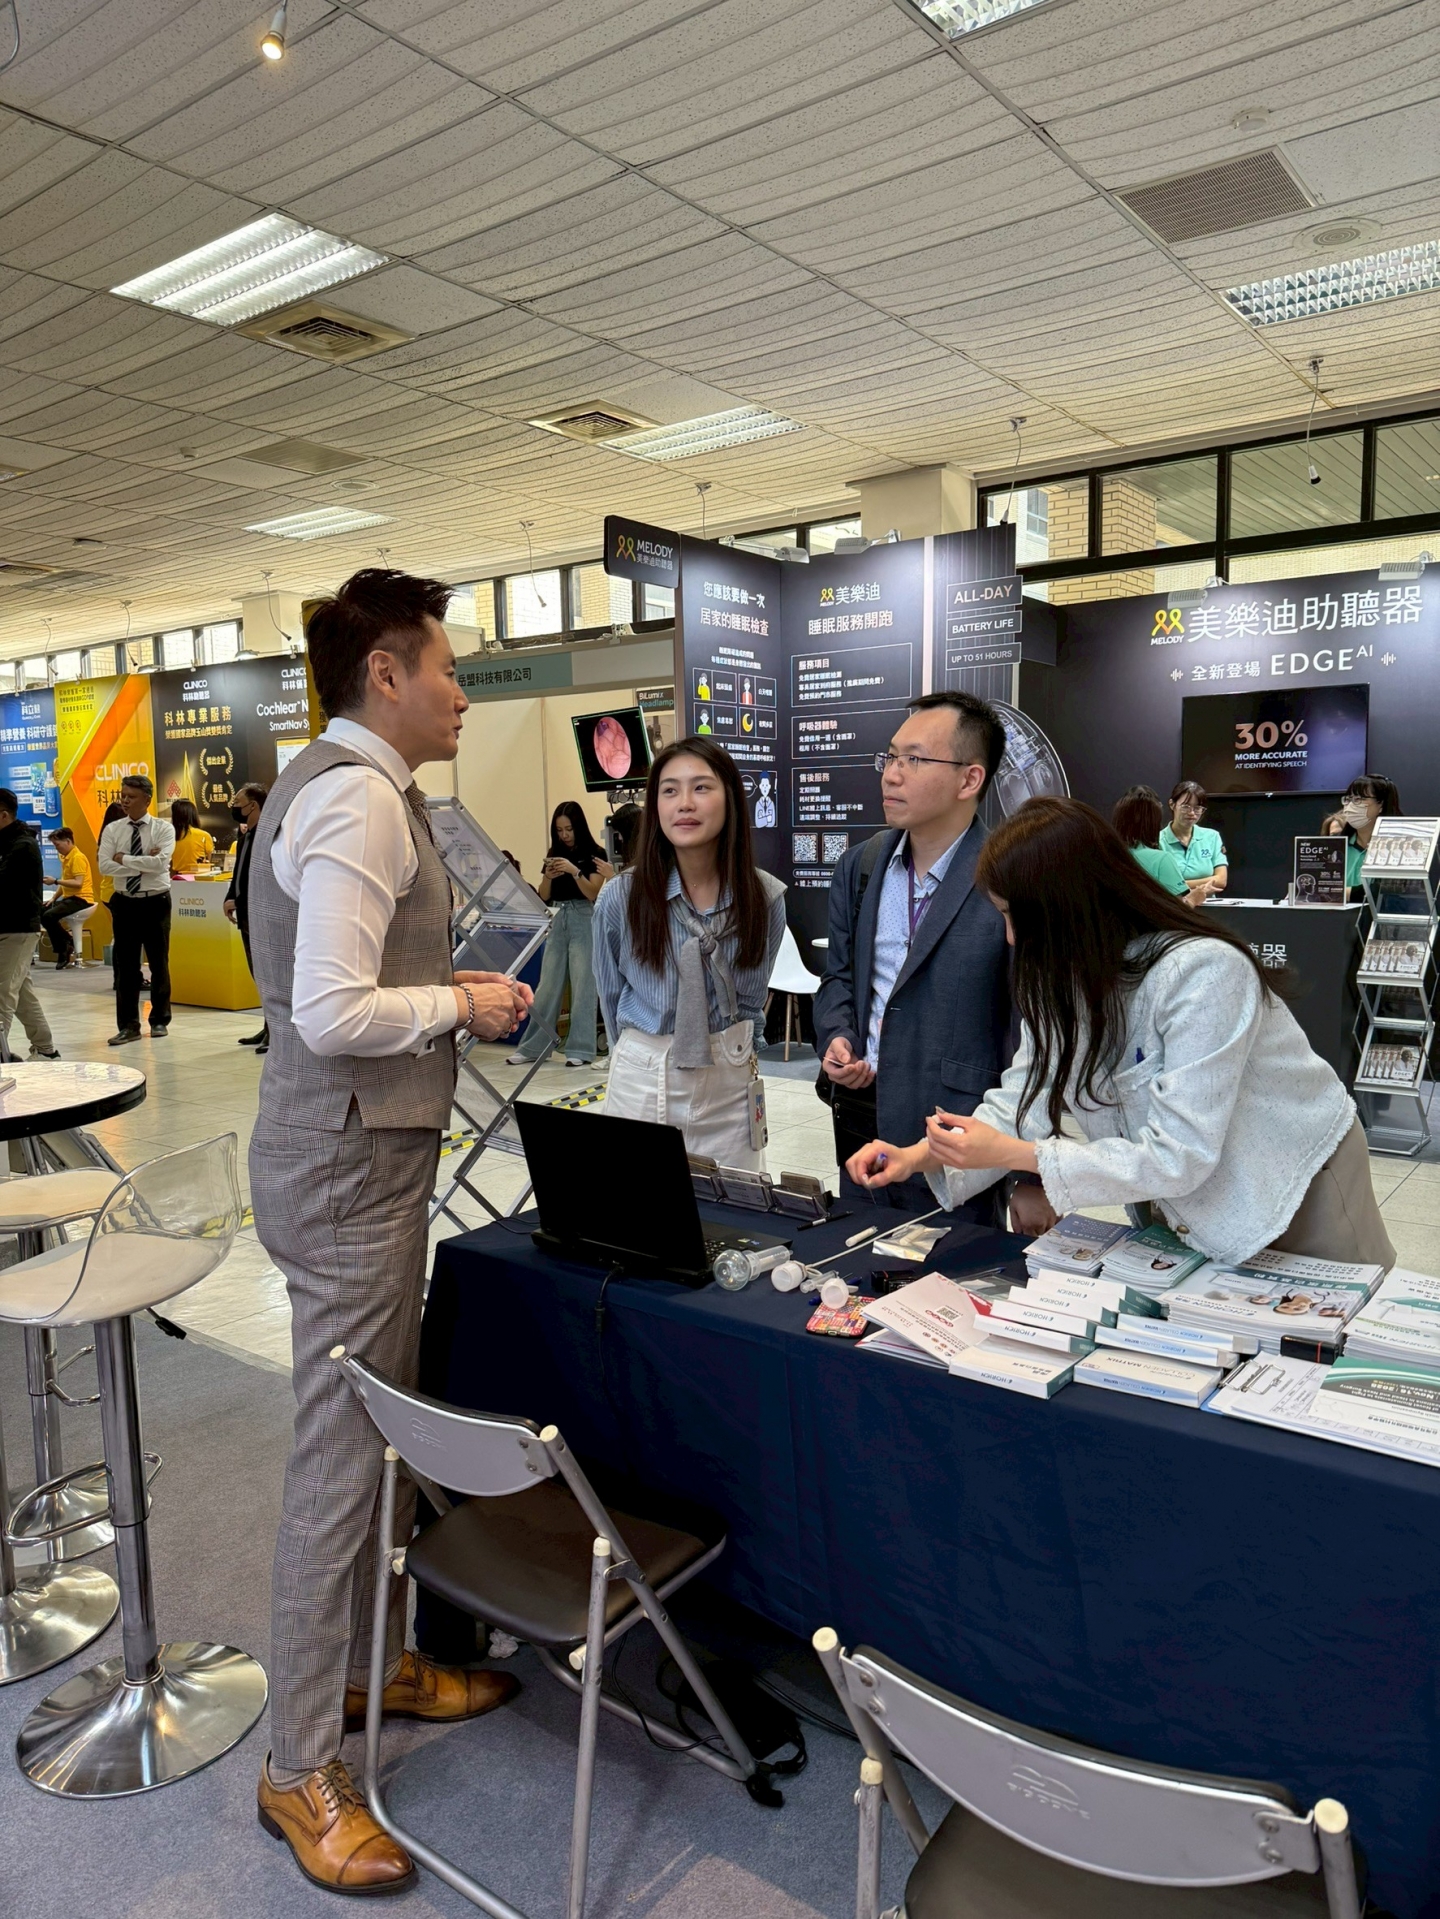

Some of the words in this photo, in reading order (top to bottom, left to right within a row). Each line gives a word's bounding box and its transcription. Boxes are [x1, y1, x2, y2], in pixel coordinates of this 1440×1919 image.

[637, 539, 674, 559] MELODY
[703, 581, 766, 609] 您應該要做一次
[835, 581, 881, 606] 美樂迪
[953, 584, 1013, 605] ALL-DAY
[1187, 584, 1424, 643] 美樂迪助聽器
[700, 607, 769, 637] 居家的睡眠檢查
[808, 609, 893, 636] 睡眠服務開跑
[952, 620, 992, 634] BATTERY
[994, 618, 1014, 629] LIFE
[1150, 635, 1185, 646] MELODY
[951, 655, 962, 663] UP
[963, 654, 974, 662] TO
[975, 653, 983, 661] 51
[985, 650, 1012, 660] HOURS
[798, 658, 830, 671] 服務項目
[1191, 661, 1261, 683] 全新登場
[1270, 649, 1354, 676] EDGE
[458, 667, 532, 687] 岳盟科技有限公司
[183, 679, 208, 690] CLINICO
[639, 699, 674, 708] Headlamp
[164, 705, 232, 727] 科林專業服務
[269, 719, 303, 732] SmartNav
[798, 720, 838, 731] 呼吸器體驗
[0, 727, 26, 742] 精準營養
[1234, 719, 1308, 750] 30%
[1234, 752, 1259, 761] MORE
[1262, 750, 1308, 760] ACCURATE
[1234, 762, 1243, 770] AT
[1244, 761, 1281, 769] IDENTIFYING
[1283, 760, 1308, 768] SPEECH
[95, 762, 149, 782] CLINICO
[798, 772, 830, 783] 售後服務
[208, 793, 229, 803] 人氣品牌
[179, 897, 204, 906] CLINICO
[1066, 1278, 1090, 1287] HORIEN
[1057, 1288, 1082, 1298] HORIEN
[1039, 1297, 1064, 1307] HORIEN
[1023, 1311, 1048, 1321] HORIEN
[1004, 1326, 1030, 1336] HORIEN
[1106, 1357, 1142, 1368] MATRIX
[1142, 1364, 1196, 1378] COLLAGEN
[981, 1372, 1007, 1384] HORIEN
